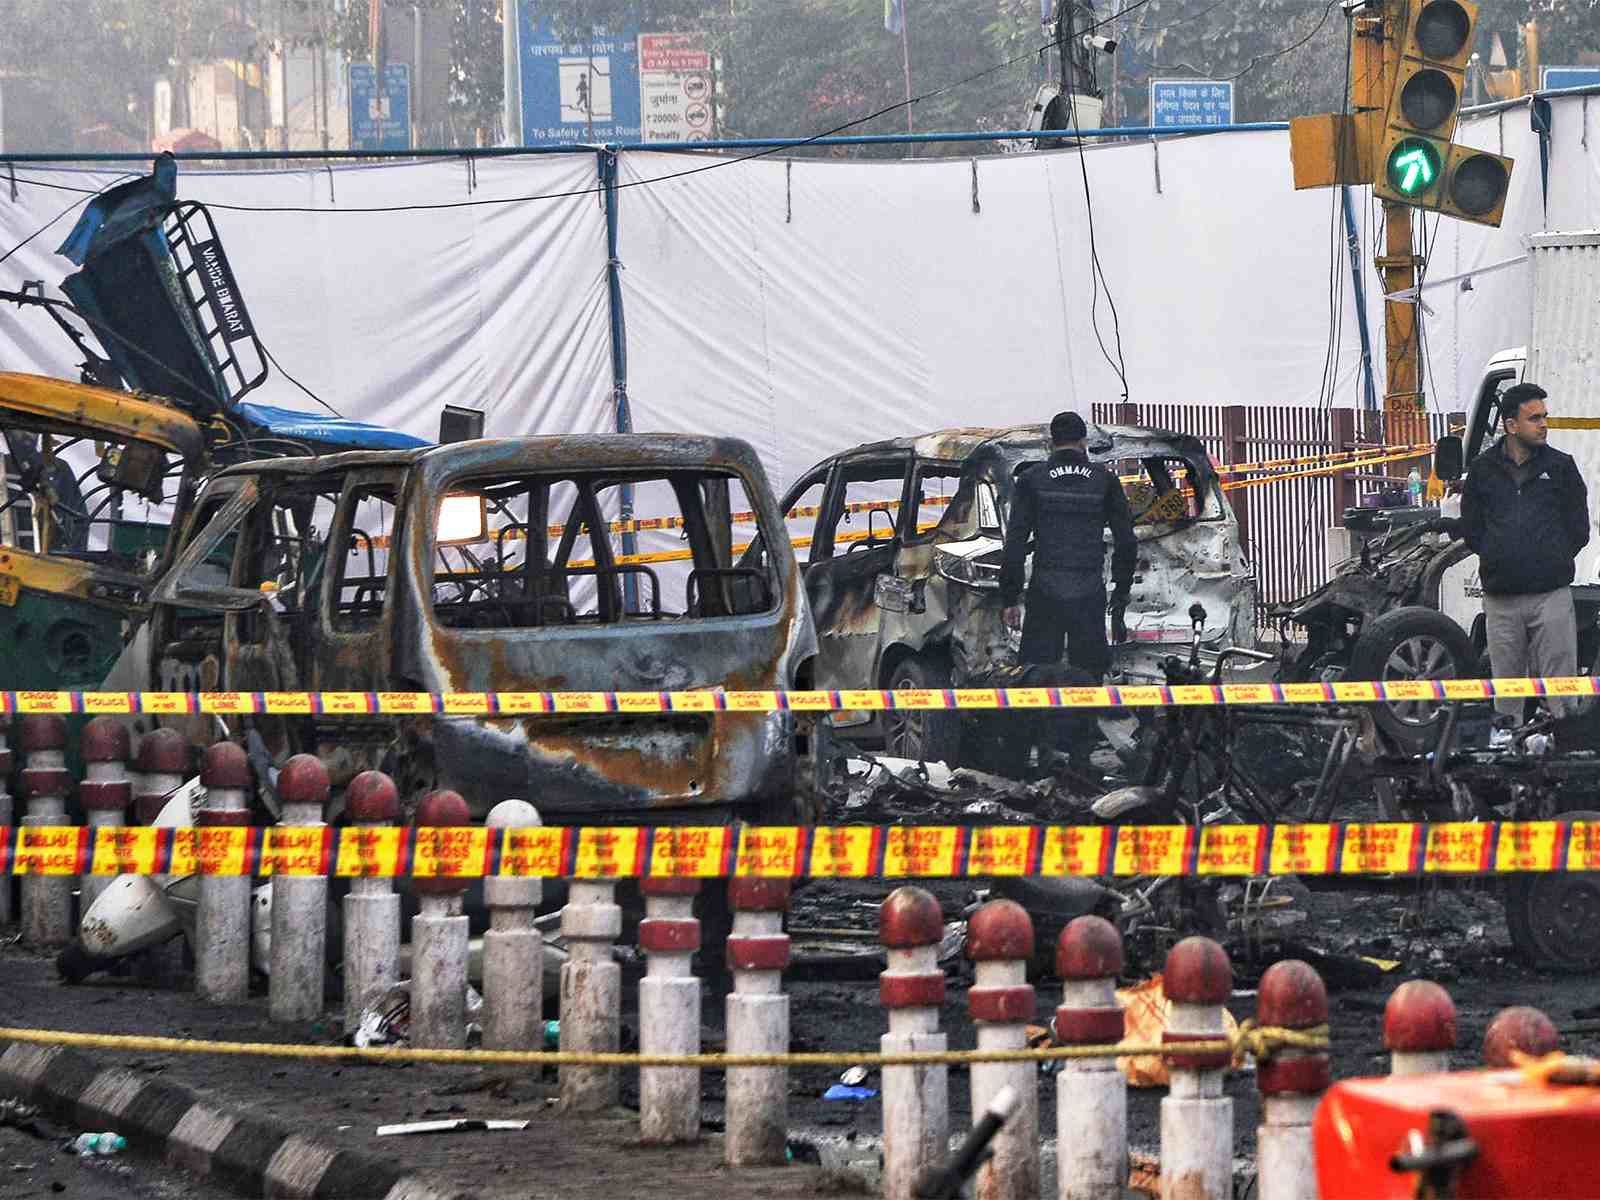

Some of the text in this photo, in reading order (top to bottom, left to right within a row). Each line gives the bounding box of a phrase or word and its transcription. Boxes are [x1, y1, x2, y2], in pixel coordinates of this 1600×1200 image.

[532, 129, 545, 139] To
[582, 127, 613, 138] Coss
[648, 130, 681, 140] Penalty
[202, 246, 226, 288] VANDE
[177, 831, 231, 843] DO NOT
[419, 831, 473, 843] DO NOT
[655, 831, 709, 843] DO NOT
[889, 831, 942, 843] DO NOT
[1119, 830, 1172, 842] DO NOT
[1347, 828, 1399, 839] DO NOT
[179, 847, 228, 858] CROSS
[420, 847, 470, 858] CROSS
[659, 847, 706, 858] CROSS
[893, 847, 939, 858] CROSS
[1122, 846, 1168, 857] CROSS
[1350, 842, 1395, 854] CROSS
[16, 854, 73, 867] POLICE
[263, 855, 318, 868] POLICE
[503, 855, 557, 869] POLICE
[739, 855, 792, 868] POLICE
[971, 853, 1022, 867] POLICE
[1200, 853, 1250, 865] POLICE
[1357, 856, 1387, 868] LINE
[1427, 850, 1477, 863] POLICE
[187, 861, 221, 873] LINE
[428, 861, 463, 873] LINE
[666, 861, 699, 873] LINE
[900, 861, 929, 872] LINE
[1129, 860, 1161, 871] LINE
